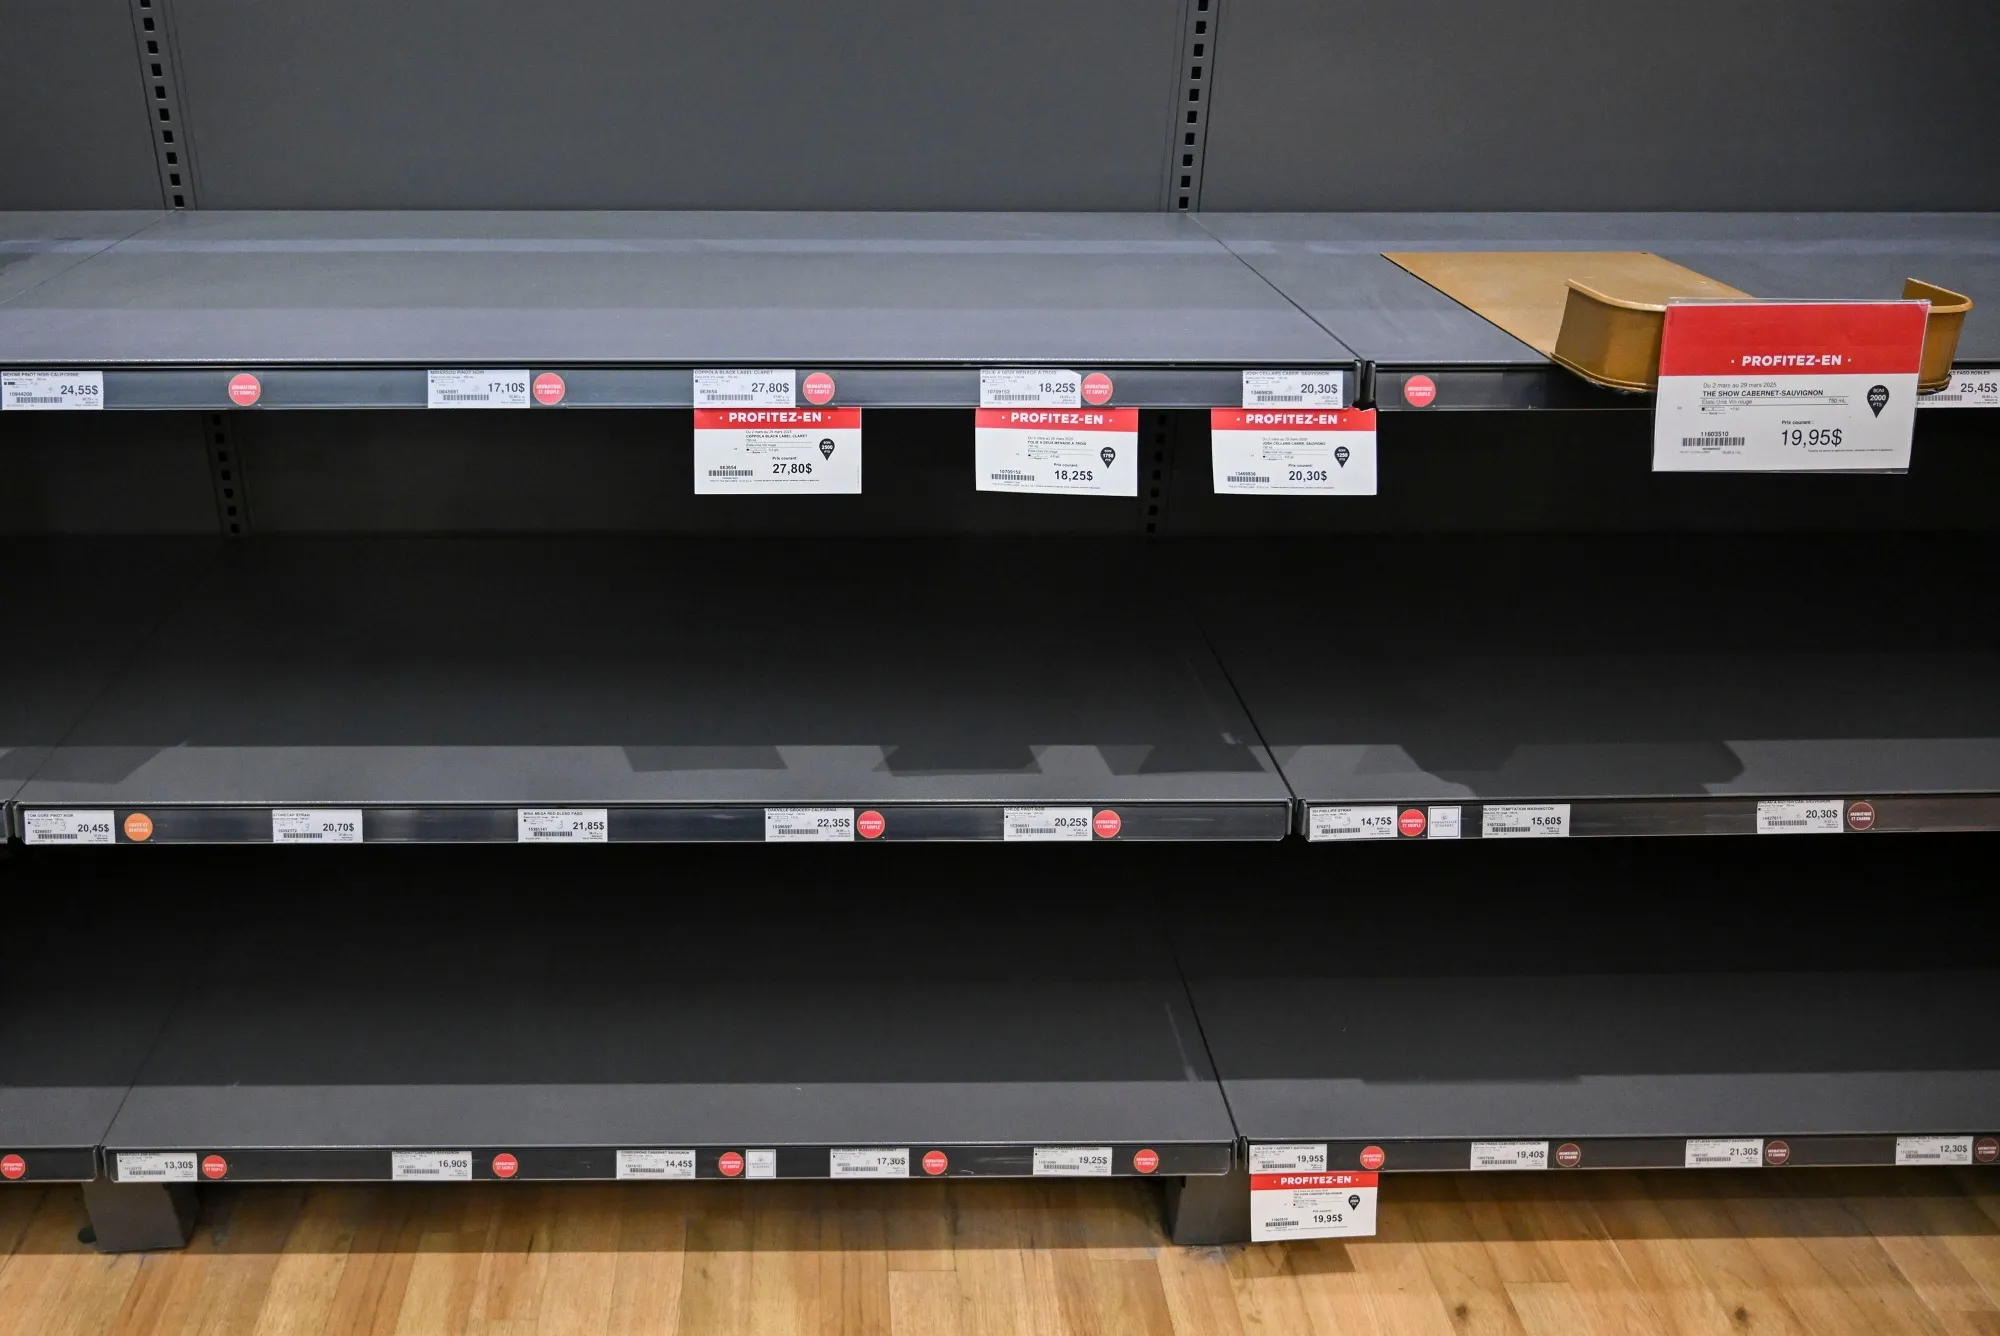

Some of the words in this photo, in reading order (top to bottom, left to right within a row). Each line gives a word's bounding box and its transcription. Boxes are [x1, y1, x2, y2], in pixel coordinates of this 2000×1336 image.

[1742, 355, 1842, 366] PROFITEZ-EN
[61, 385, 99, 396] 24,55$
[488, 383, 525, 393] 17,10$
[752, 383, 789, 394] 27,80$
[1039, 383, 1076, 394] 18,25$
[1301, 384, 1338, 395] 20,30$
[1960, 383, 1997, 394] 25,45$
[729, 412, 822, 422] PROFITEZ-EN
[1011, 412, 1103, 424] PROFITEZ-EN
[1246, 414, 1338, 424] PROFITEZ-EN
[1781, 428, 1842, 448] 19,95$
[772, 463, 812, 475] 27,80$
[1054, 470, 1093, 482] 18,25$
[1288, 470, 1327, 482] 20,30$
[1806, 810, 1838, 820] 20,30$
[573, 821, 605, 831] 21,85$
[817, 819, 850, 829] 22,35$
[1054, 818, 1088, 828] 20,25$
[1361, 817, 1392, 827] 14,75$
[1531, 817, 1561, 826] 15,60$
[78, 824, 110, 834] 20,45$
[323, 823, 354, 832] 20,70$
[1730, 1148, 1758, 1156] 21,30$
[1940, 1145, 1968, 1153] 12,30$
[1297, 1155, 1324, 1163] 19,95$
[1516, 1151, 1544, 1159] 19,40$
[165, 1161, 193, 1170] 13,30$
[438, 1160, 467, 1168] 16,90$
[665, 1160, 693, 1168] 14,45$
[877, 1158, 905, 1166] 17,30$
[1079, 1157, 1108, 1165] 19,25$
[1281, 1176, 1351, 1184] PROFITEZ-EN
[1313, 1214, 1343, 1224] 19,95$
